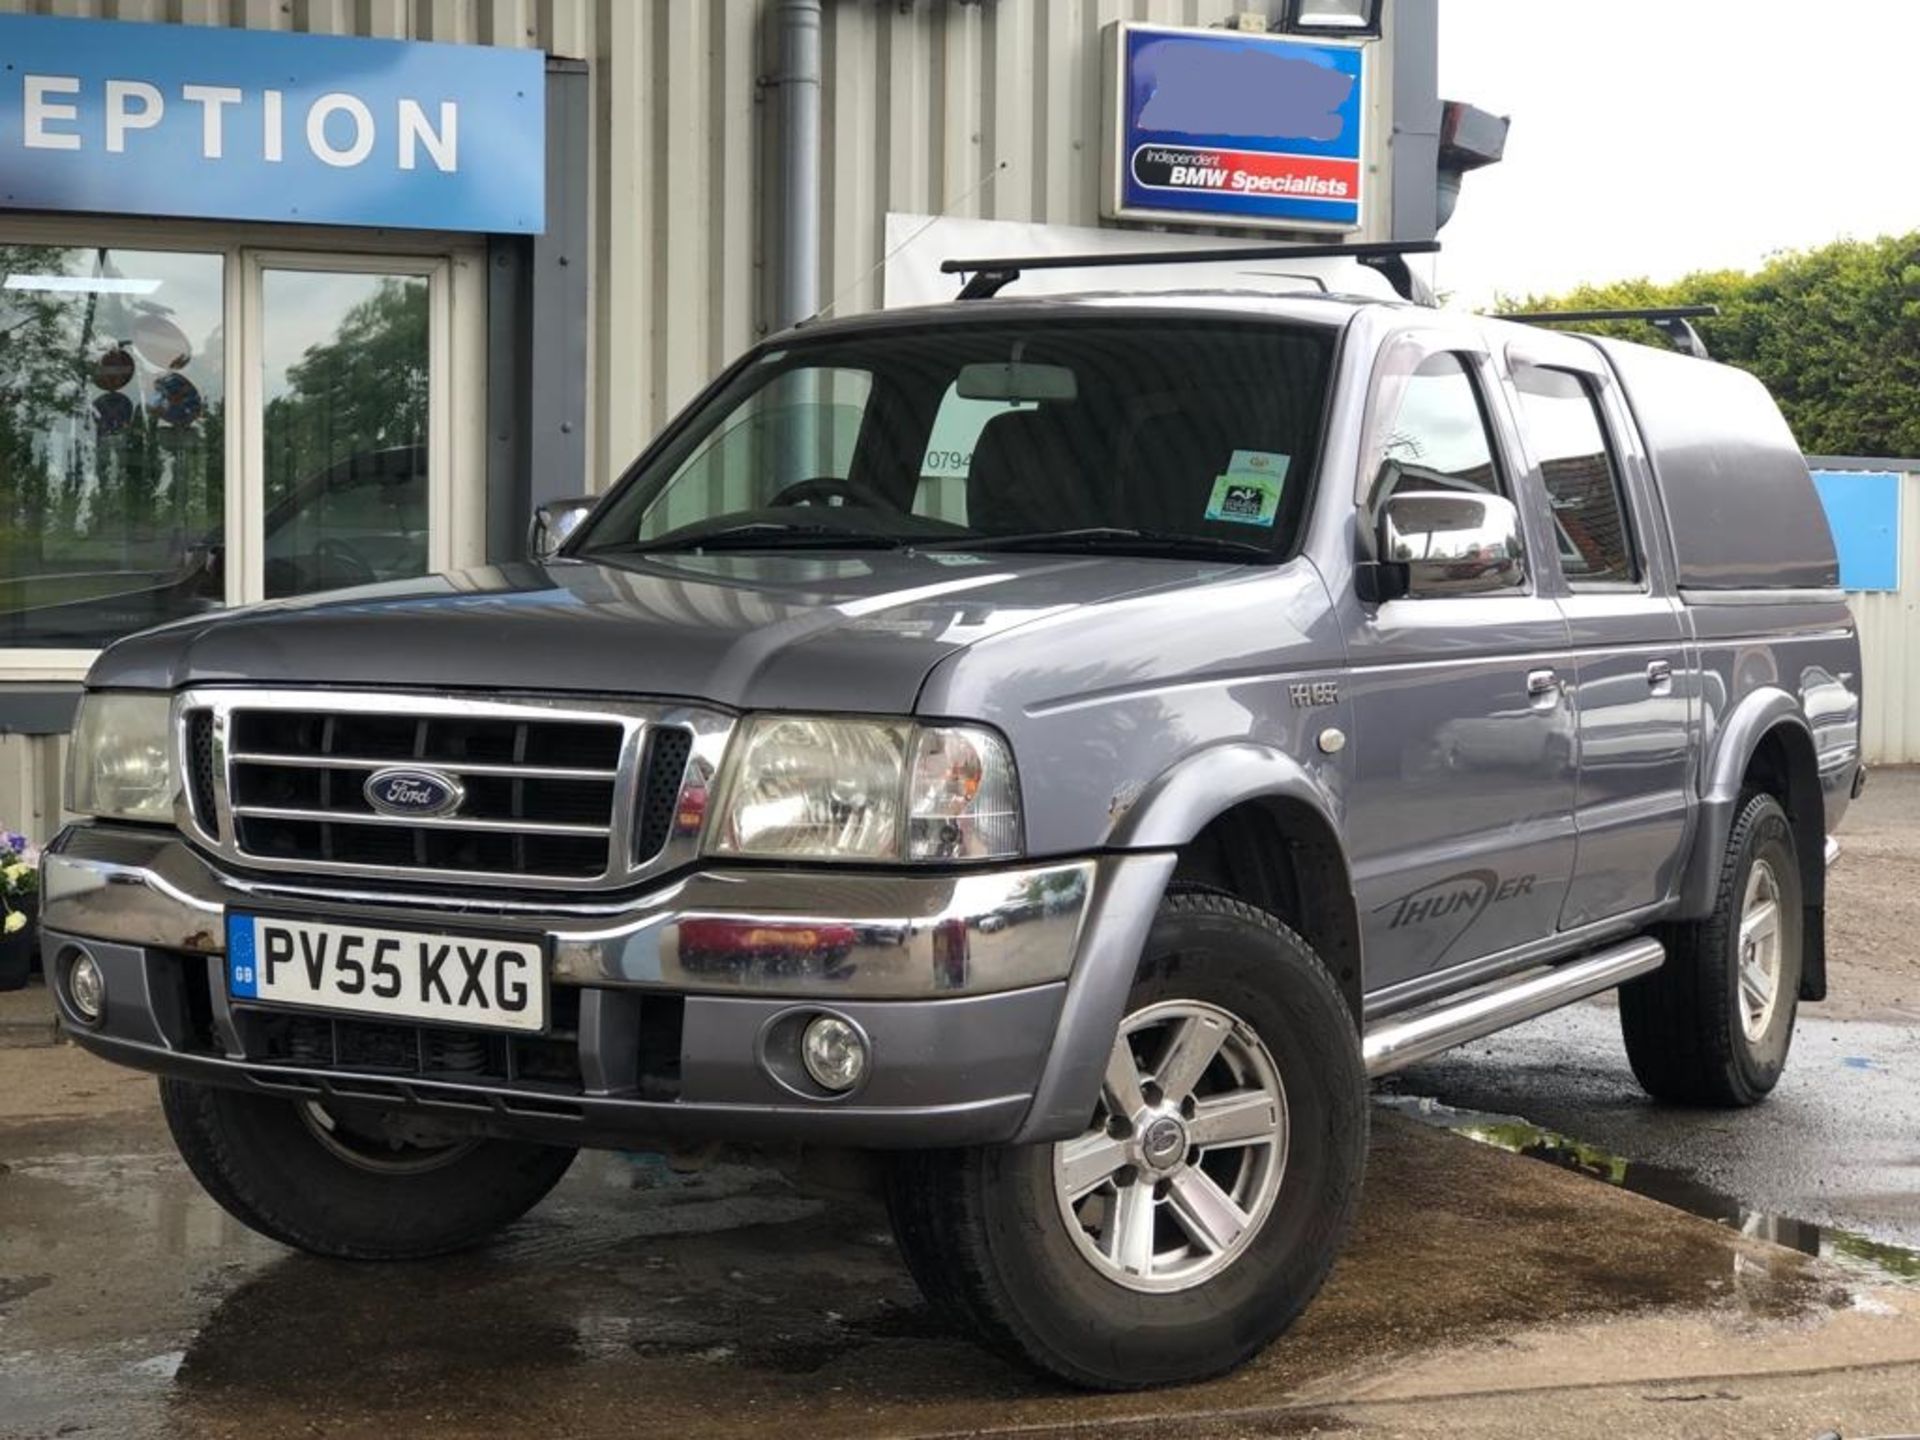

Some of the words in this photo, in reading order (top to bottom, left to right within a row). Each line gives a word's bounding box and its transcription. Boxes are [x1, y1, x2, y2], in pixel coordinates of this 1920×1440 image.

[23, 74, 459, 173] EPTION
[1146, 150, 1221, 167] Independent
[1169, 166, 1229, 187] BMW
[1231, 171, 1348, 196] Specialists
[387, 779, 432, 804] Ford
[1372, 869, 1536, 966] THUNDER
[235, 966, 252, 983] GB
[263, 927, 402, 999] PV55
[419, 942, 528, 1012] KXG
